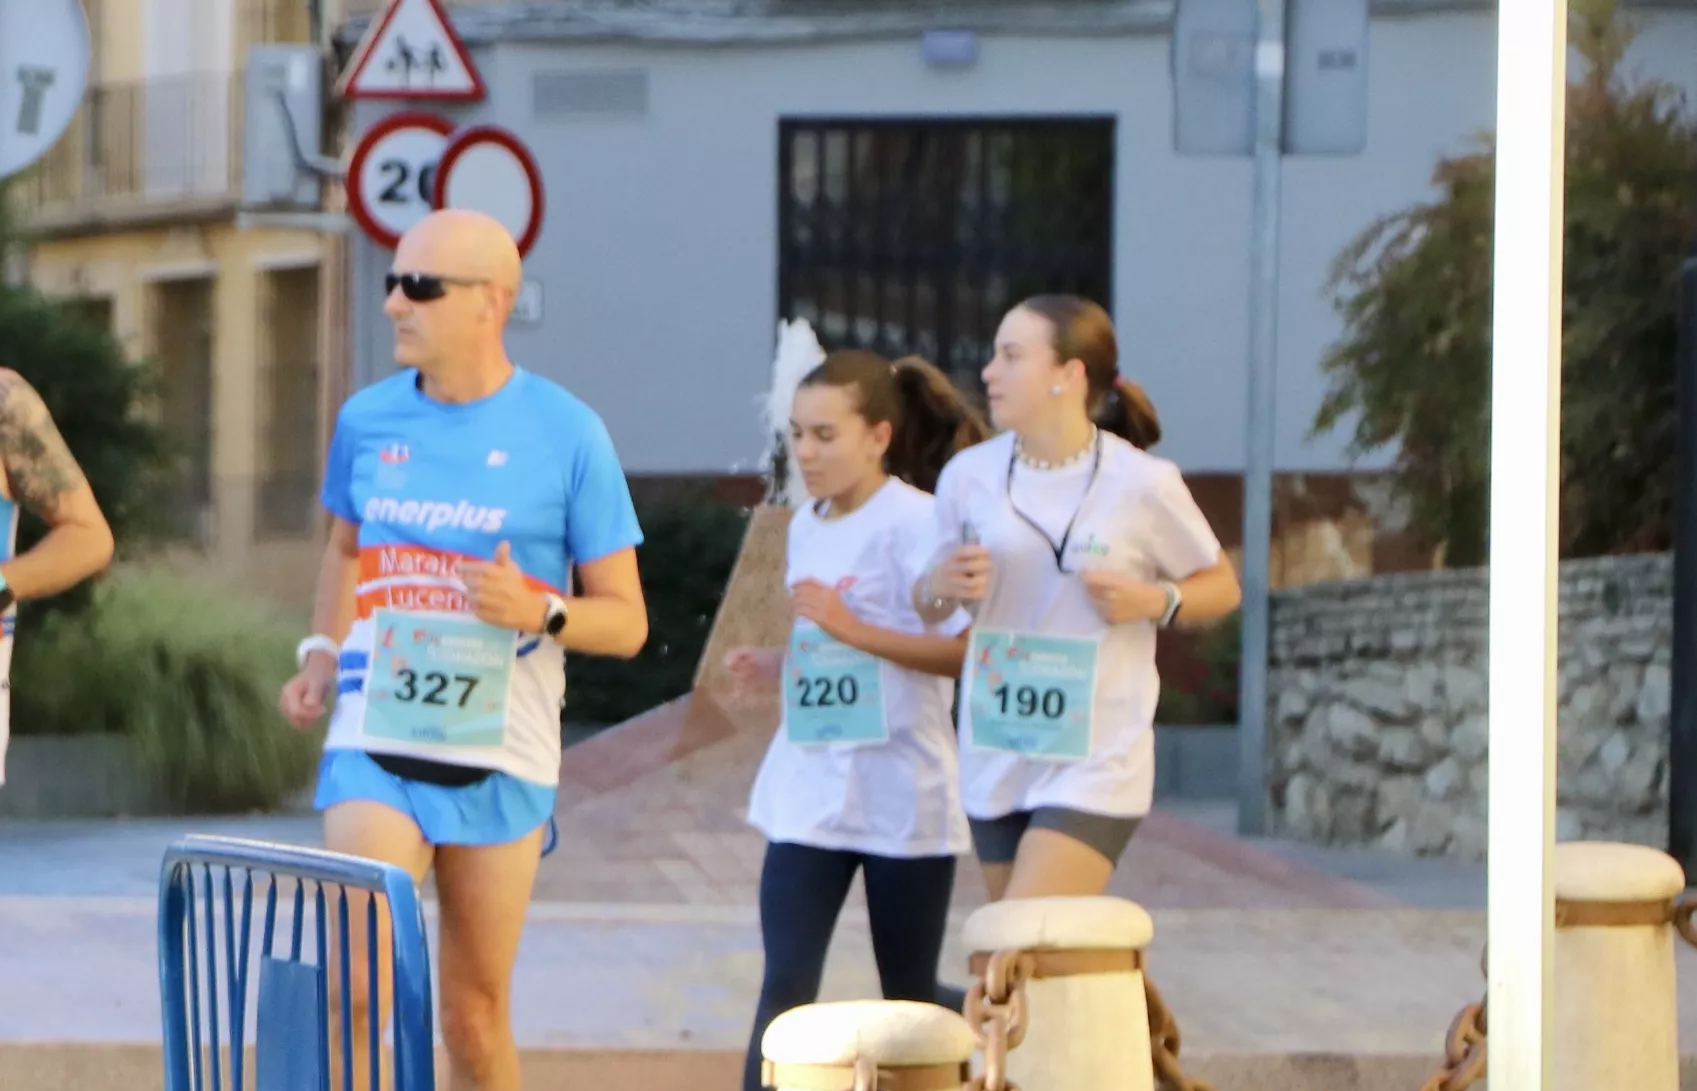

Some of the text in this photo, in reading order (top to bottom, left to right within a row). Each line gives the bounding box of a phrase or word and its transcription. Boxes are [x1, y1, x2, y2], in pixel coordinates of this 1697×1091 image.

[365, 497, 507, 532] enerplus
[386, 587, 470, 612] Lucen
[395, 668, 479, 707] 327
[797, 675, 859, 708] 220
[995, 684, 1065, 718] 190
